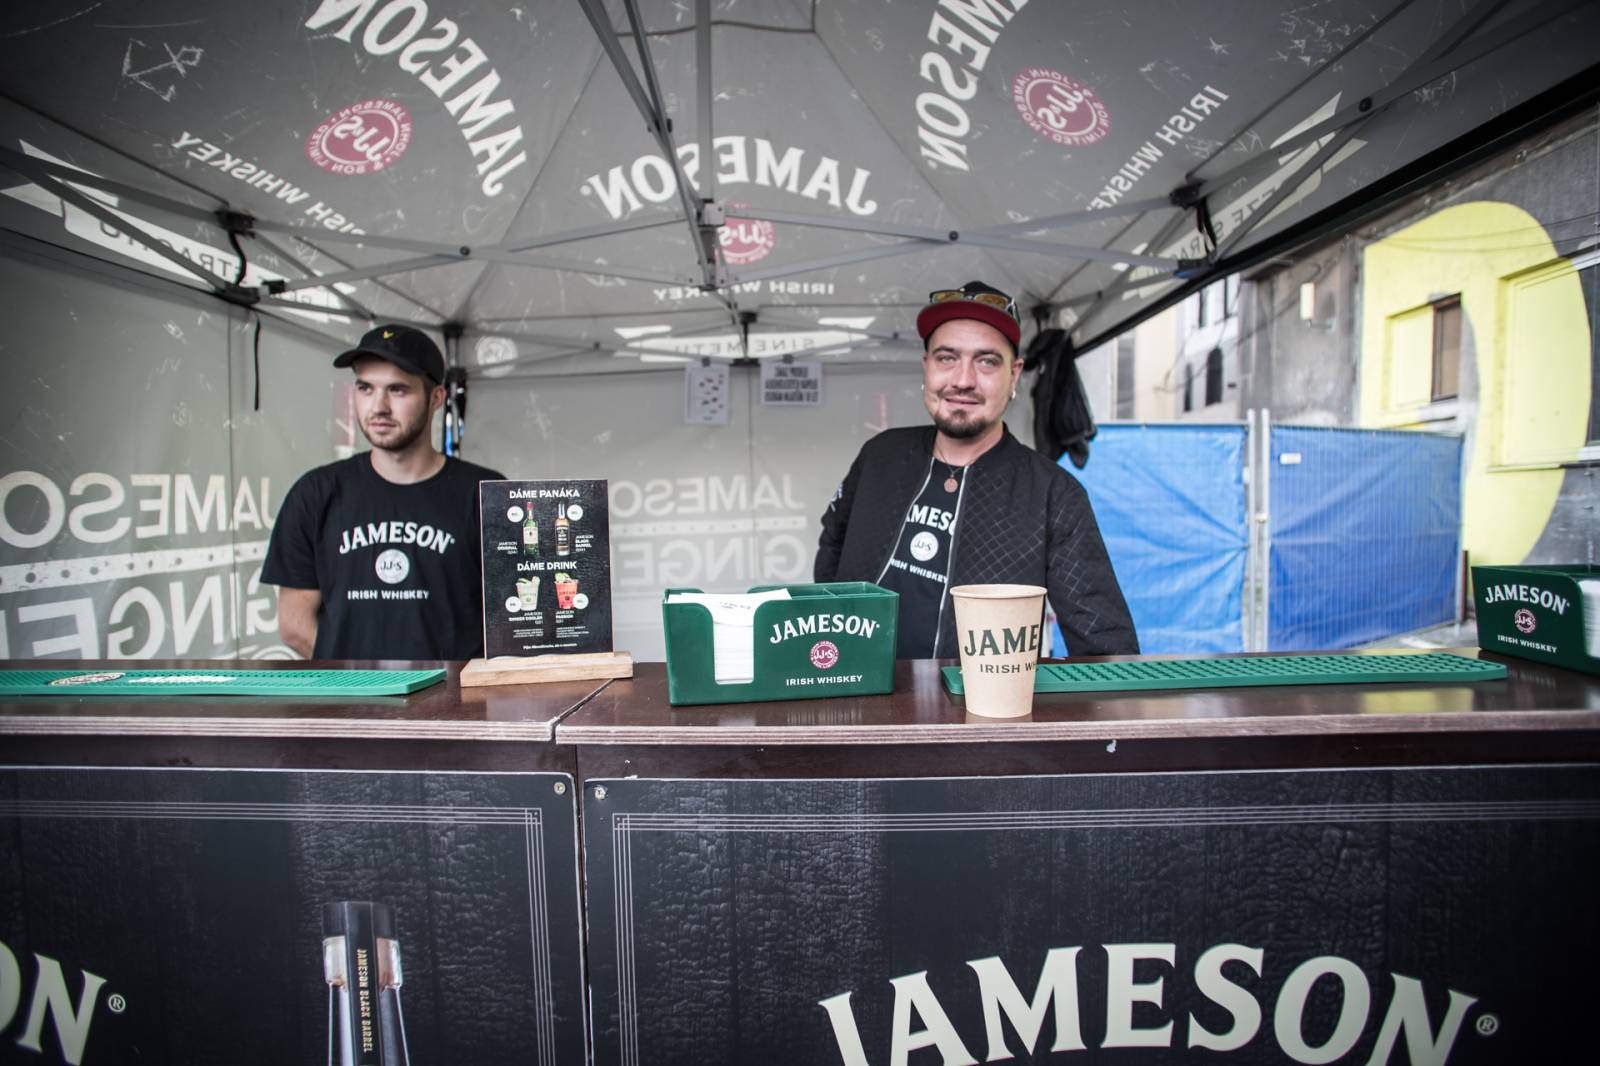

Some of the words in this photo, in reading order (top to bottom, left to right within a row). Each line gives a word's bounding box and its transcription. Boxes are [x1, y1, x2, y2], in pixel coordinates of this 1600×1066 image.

[509, 488, 537, 499] DÁME
[539, 487, 580, 498] PANÁKA
[339, 520, 453, 554] JAMESON
[517, 561, 545, 571] DÁME
[547, 561, 577, 571] DRINK
[347, 590, 378, 600] IRISH
[381, 590, 429, 600] WHISKEY
[1485, 584, 1568, 615] JAMESON
[769, 614, 877, 644] JAMESON
[1497, 634, 1518, 645] IRISH
[1520, 639, 1558, 654] WHISKEY
[786, 678, 814, 686] IRISH
[817, 674, 863, 685] WHISKEY
[980, 663, 1020, 674] IRISH
[357, 948, 369, 988] JAMESON
[360, 989, 371, 1018] BLACK
[362, 1019, 374, 1053] BARREL
